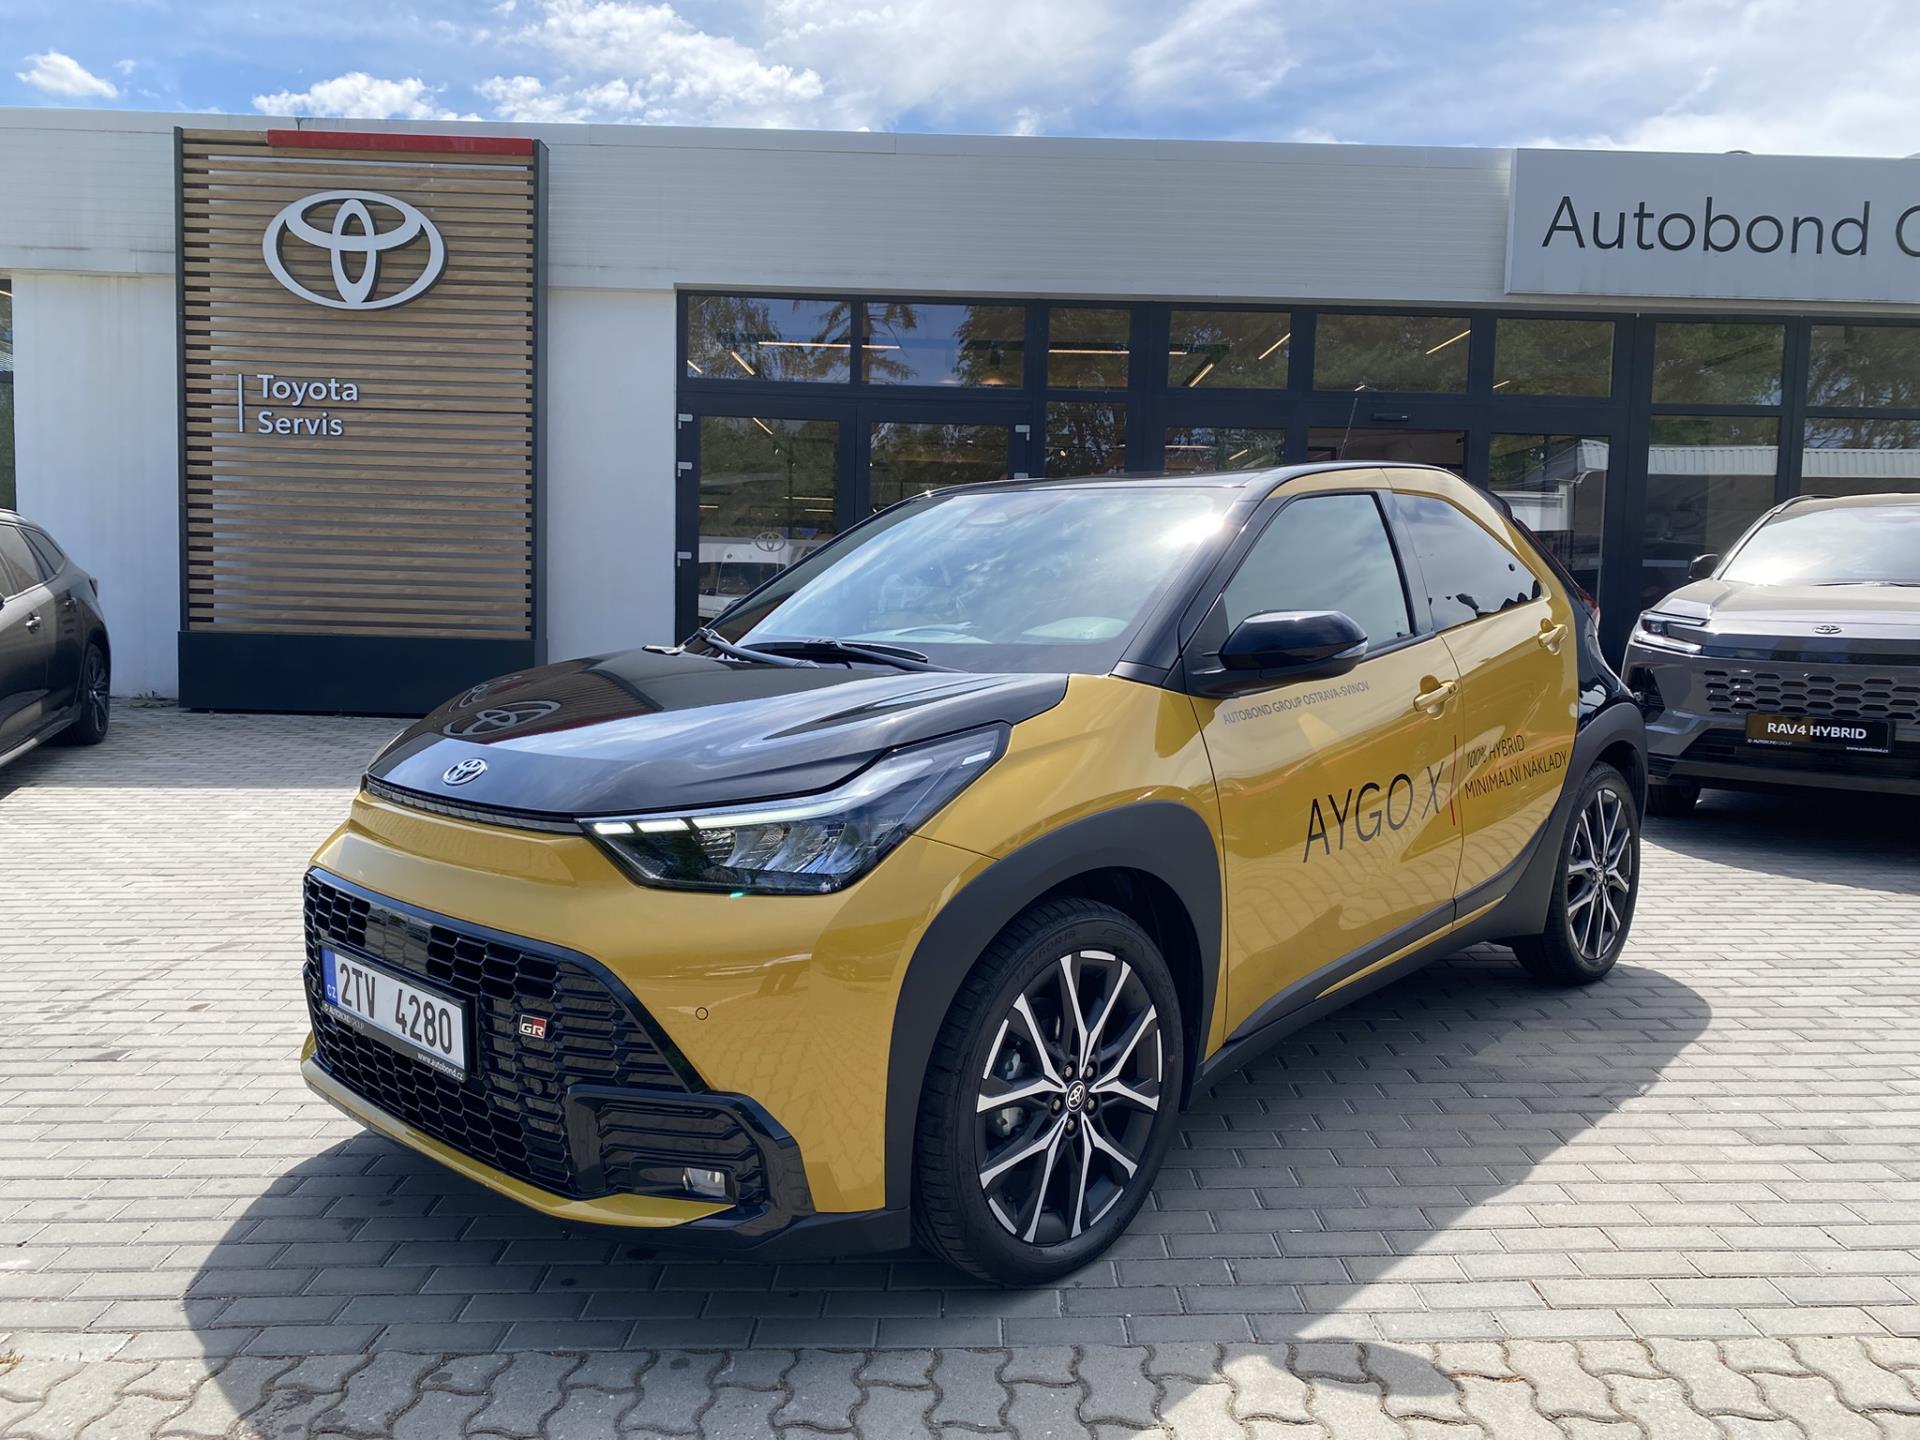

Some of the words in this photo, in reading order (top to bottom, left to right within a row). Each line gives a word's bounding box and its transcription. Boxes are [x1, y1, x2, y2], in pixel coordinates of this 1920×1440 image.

[1542, 196, 1870, 256] Autobond
[257, 374, 358, 406] Toyota
[258, 411, 343, 435] Servis
[1223, 703, 1273, 724] AUTOBOND
[1273, 697, 1302, 713] GROUP
[1303, 681, 1370, 706] OSTRAVA-SVINOV
[1767, 722, 1806, 735] RAV4
[1809, 725, 1867, 739] HYBRID
[1467, 744, 1487, 769] 100%
[1488, 735, 1525, 761] HYBRID
[1464, 760, 1521, 800] MINIMÁLNÍ
[1523, 750, 1568, 779] NÁKLADY
[1303, 773, 1413, 863] AYGO
[1421, 761, 1445, 820] X
[326, 984, 337, 999] CZ
[340, 963, 376, 1019] 2TV
[395, 988, 452, 1055] 4280
[521, 1022, 545, 1037] GR
